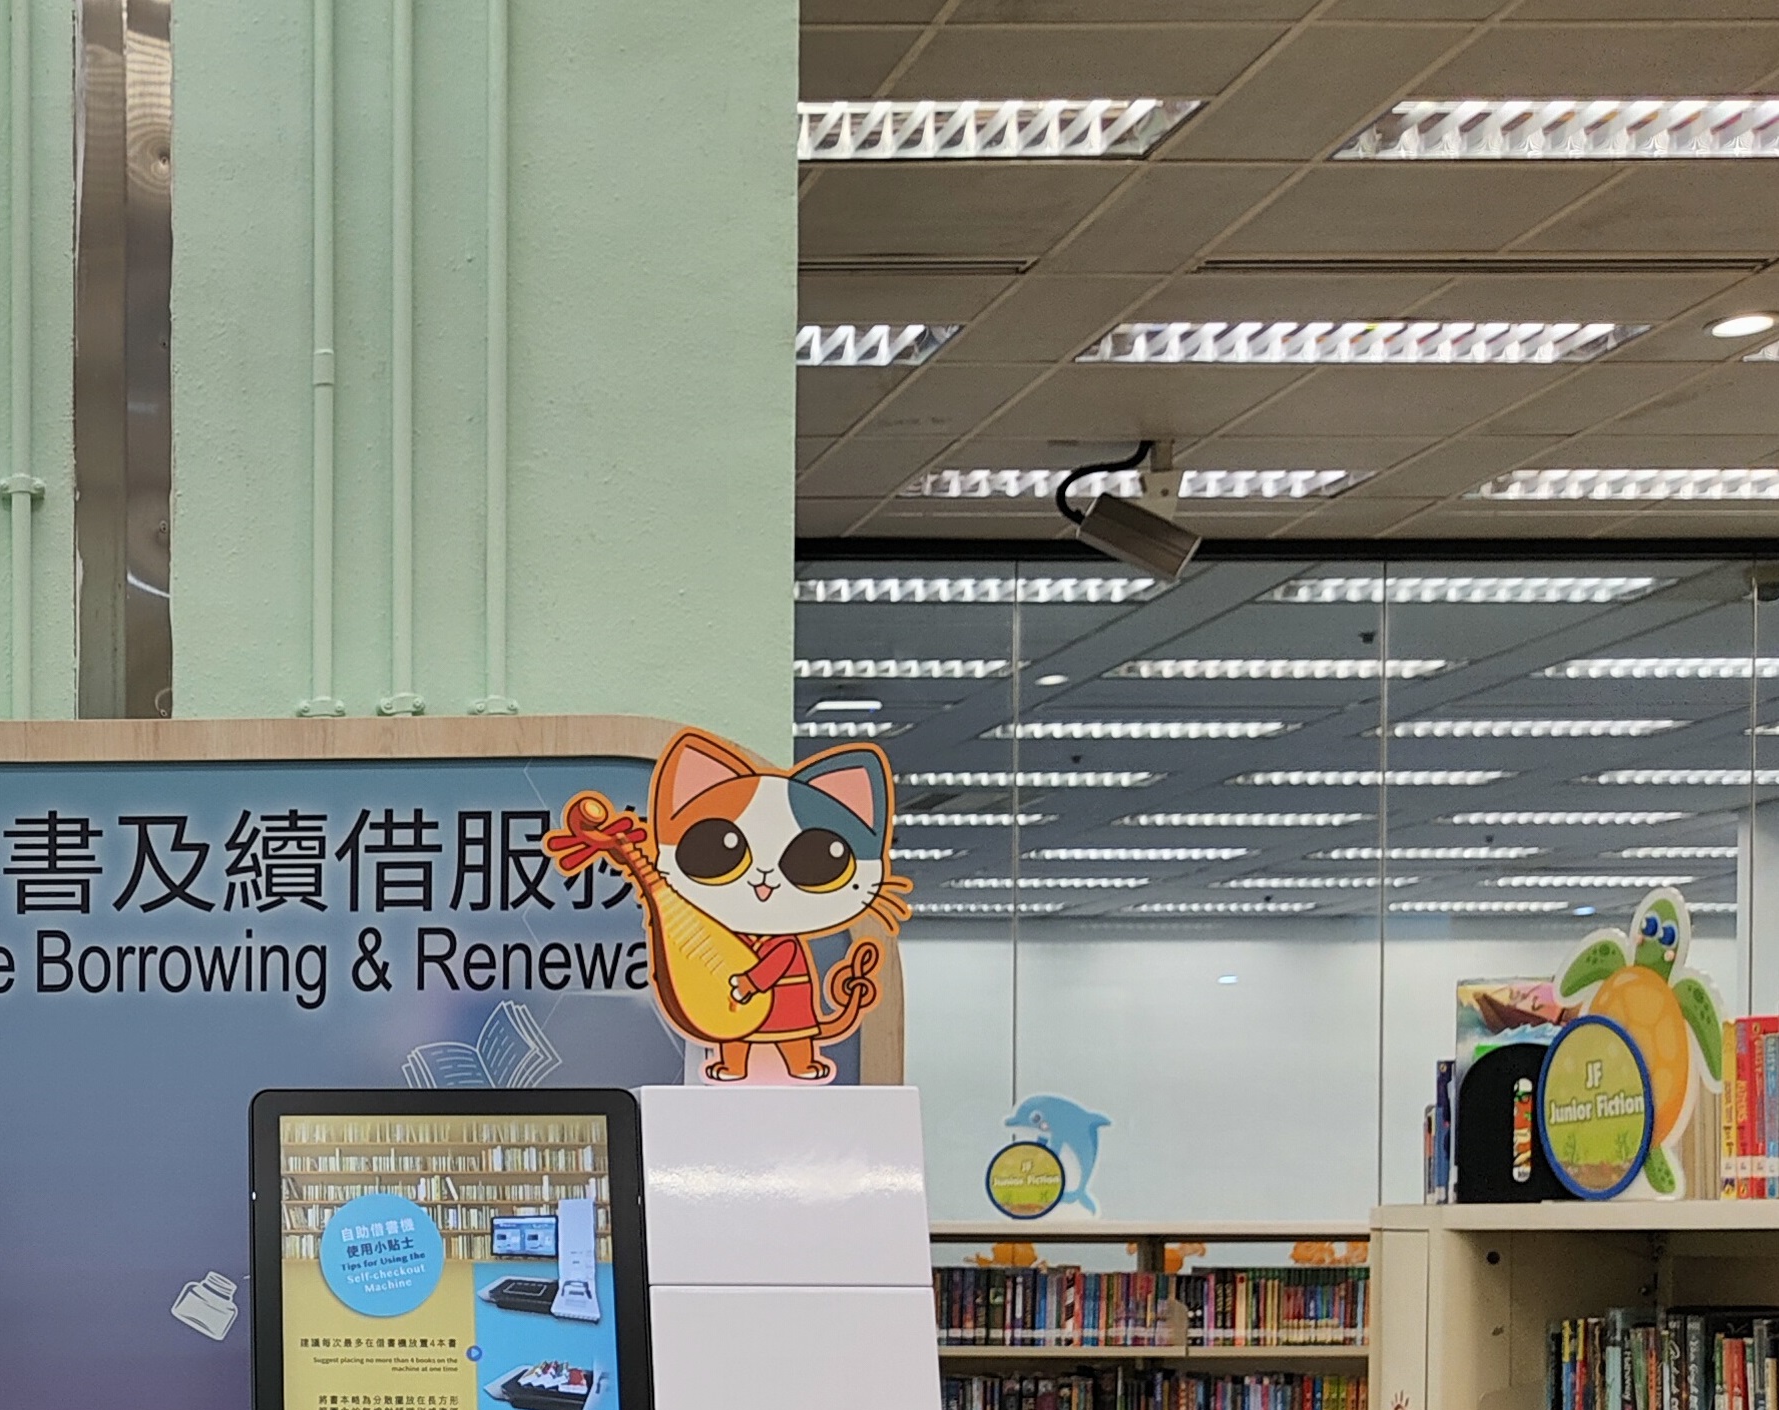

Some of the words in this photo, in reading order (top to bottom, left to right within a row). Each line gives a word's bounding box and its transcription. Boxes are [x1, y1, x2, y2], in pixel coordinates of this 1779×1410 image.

[36, 928, 328, 1010] Borrowing
[351, 931, 393, 992] &
[416, 926, 650, 990] Renewa
[1585, 1060, 1602, 1089] JF
[1550, 1099, 1593, 1124] Junior
[1596, 1092, 1644, 1117] Fiction
[341, 1218, 415, 1242] 自助借書機
[347, 1236, 414, 1258] 使用小貼士
[342, 1263, 361, 1271] Tips
[364, 1260, 377, 1268] for
[380, 1255, 408, 1265] Using
[409, 1252, 425, 1260] the
[347, 1264, 425, 1284] Self-checkout
[364, 1279, 412, 1293] Machine
